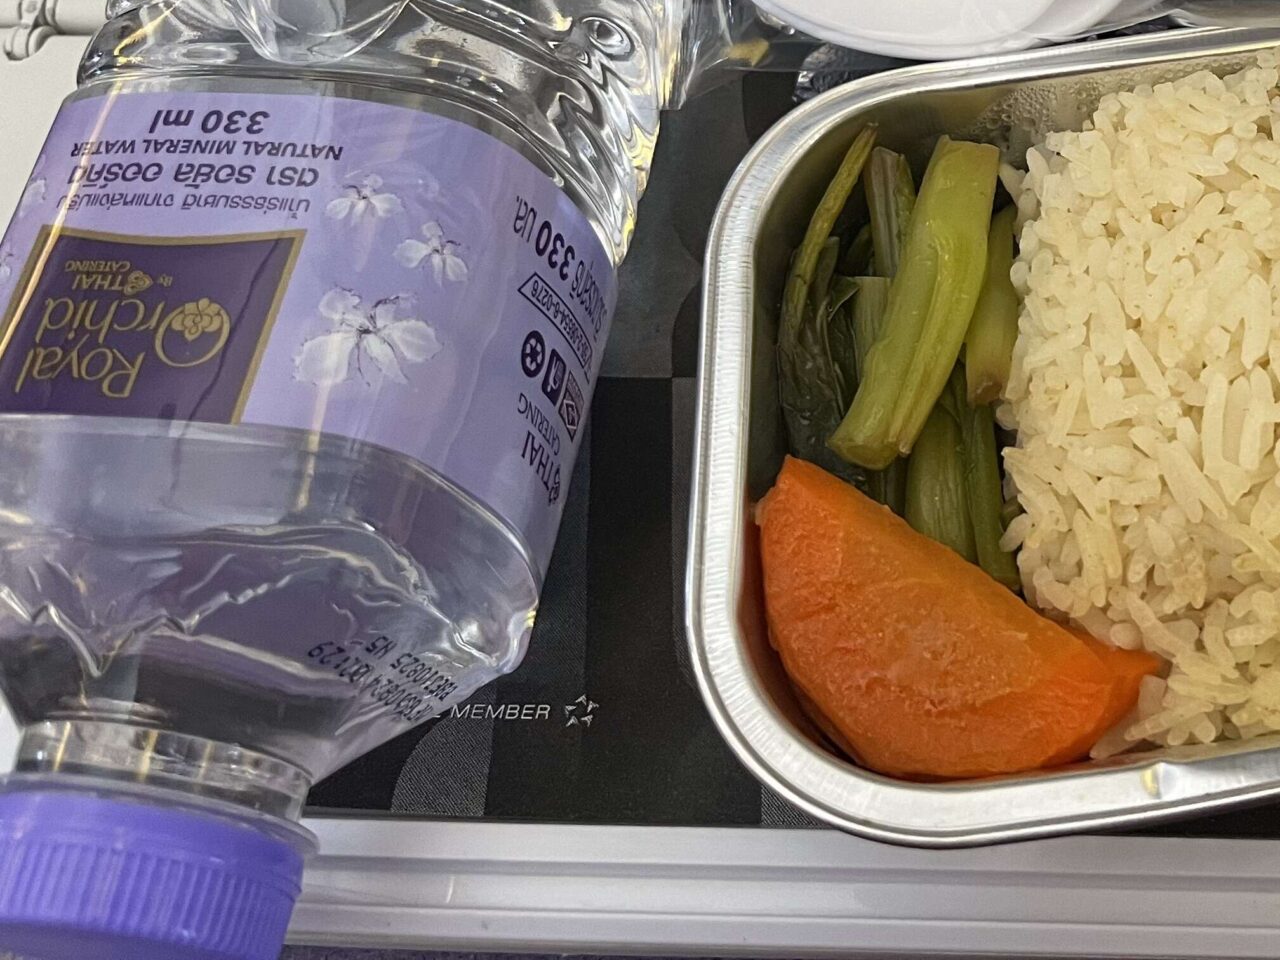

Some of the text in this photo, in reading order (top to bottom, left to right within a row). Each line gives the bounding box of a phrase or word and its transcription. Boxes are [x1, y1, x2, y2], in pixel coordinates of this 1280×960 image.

[150, 109, 270, 135] 330 ml
[70, 139, 344, 161] NATURAL MINERAL WATER
[173, 162, 257, 190] รอยัล
[265, 164, 320, 188] ตรา
[513, 195, 538, 243] มล.
[534, 220, 577, 282] 330
[65, 260, 131, 272] CATERING
[72, 274, 126, 291] THAI
[34, 297, 232, 368] Orchid
[15, 334, 146, 399] Royal
[517, 392, 561, 456] CATERING
[521, 430, 552, 491] THAI
[450, 704, 551, 720] MEMBER
